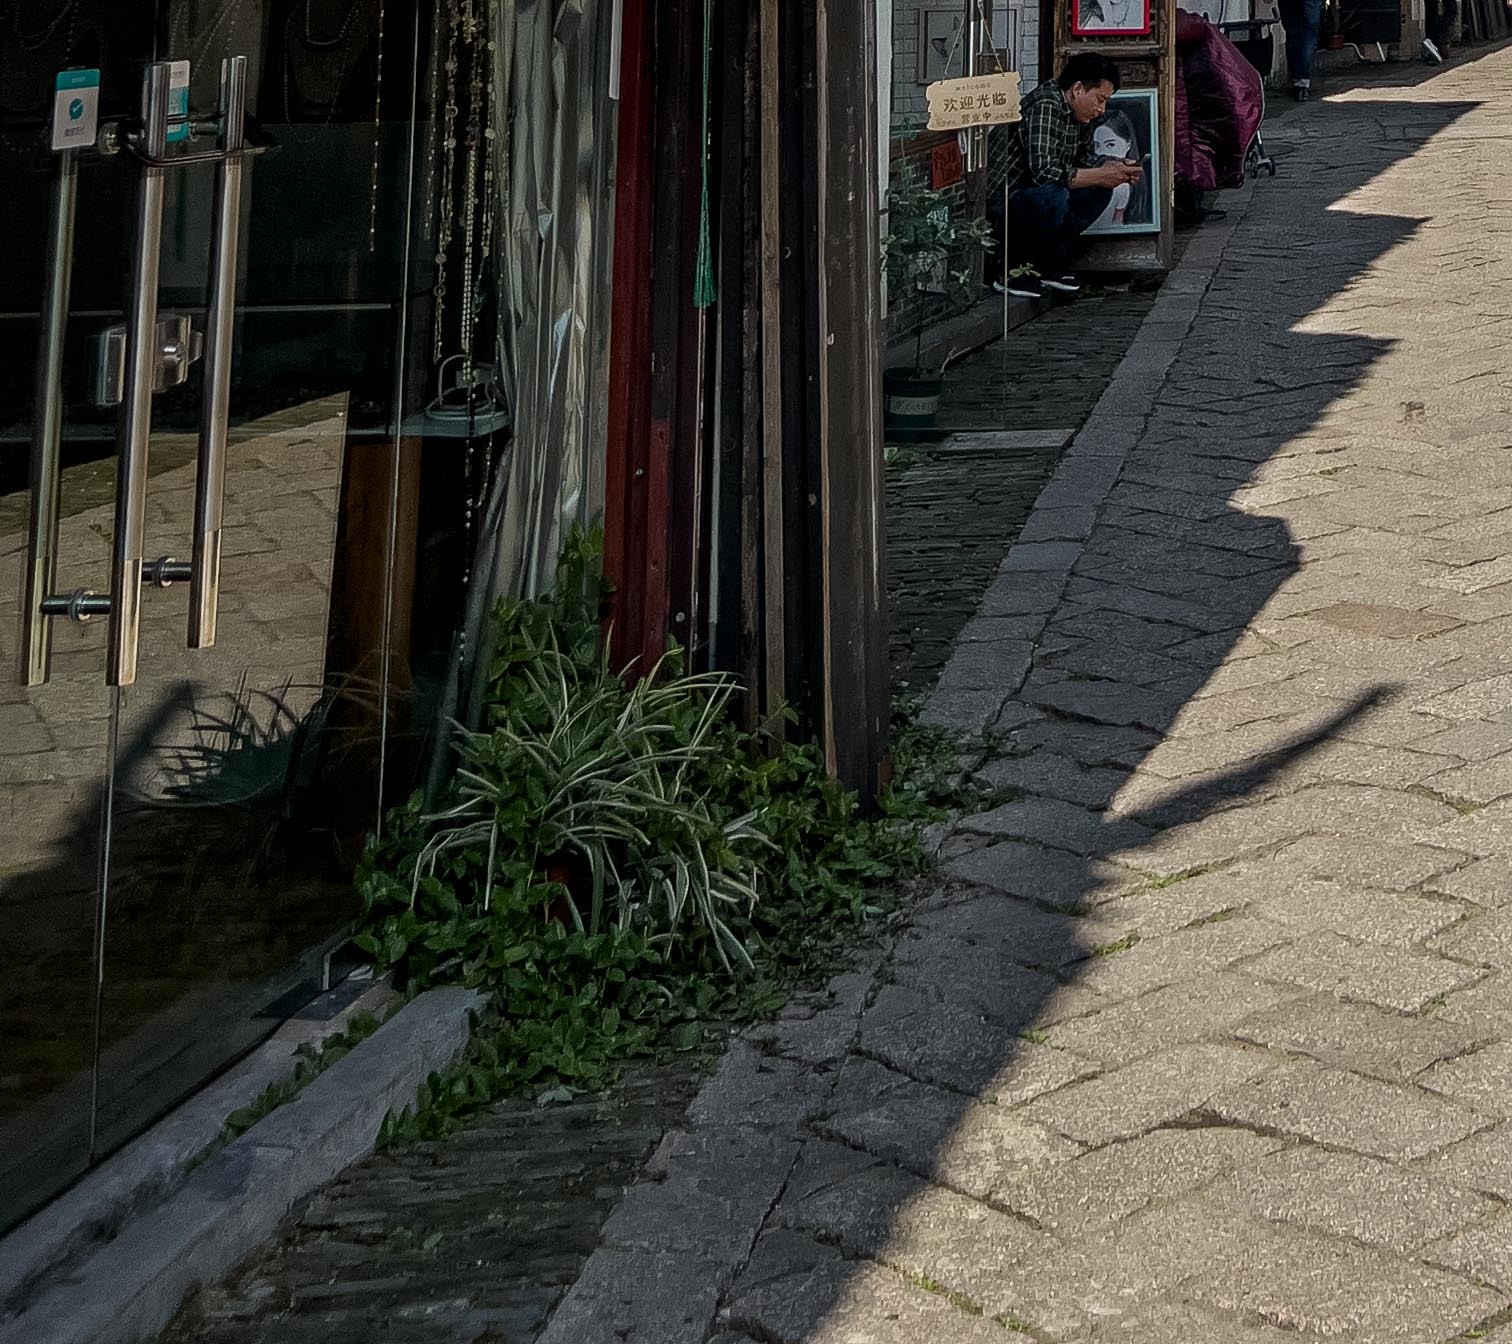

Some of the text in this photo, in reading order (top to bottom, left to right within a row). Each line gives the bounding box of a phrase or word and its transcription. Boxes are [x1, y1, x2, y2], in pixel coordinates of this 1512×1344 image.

[955, 82, 992, 91] welcome
[943, 92, 1007, 112] 欢迎光临
[961, 111, 992, 125] 营业中
